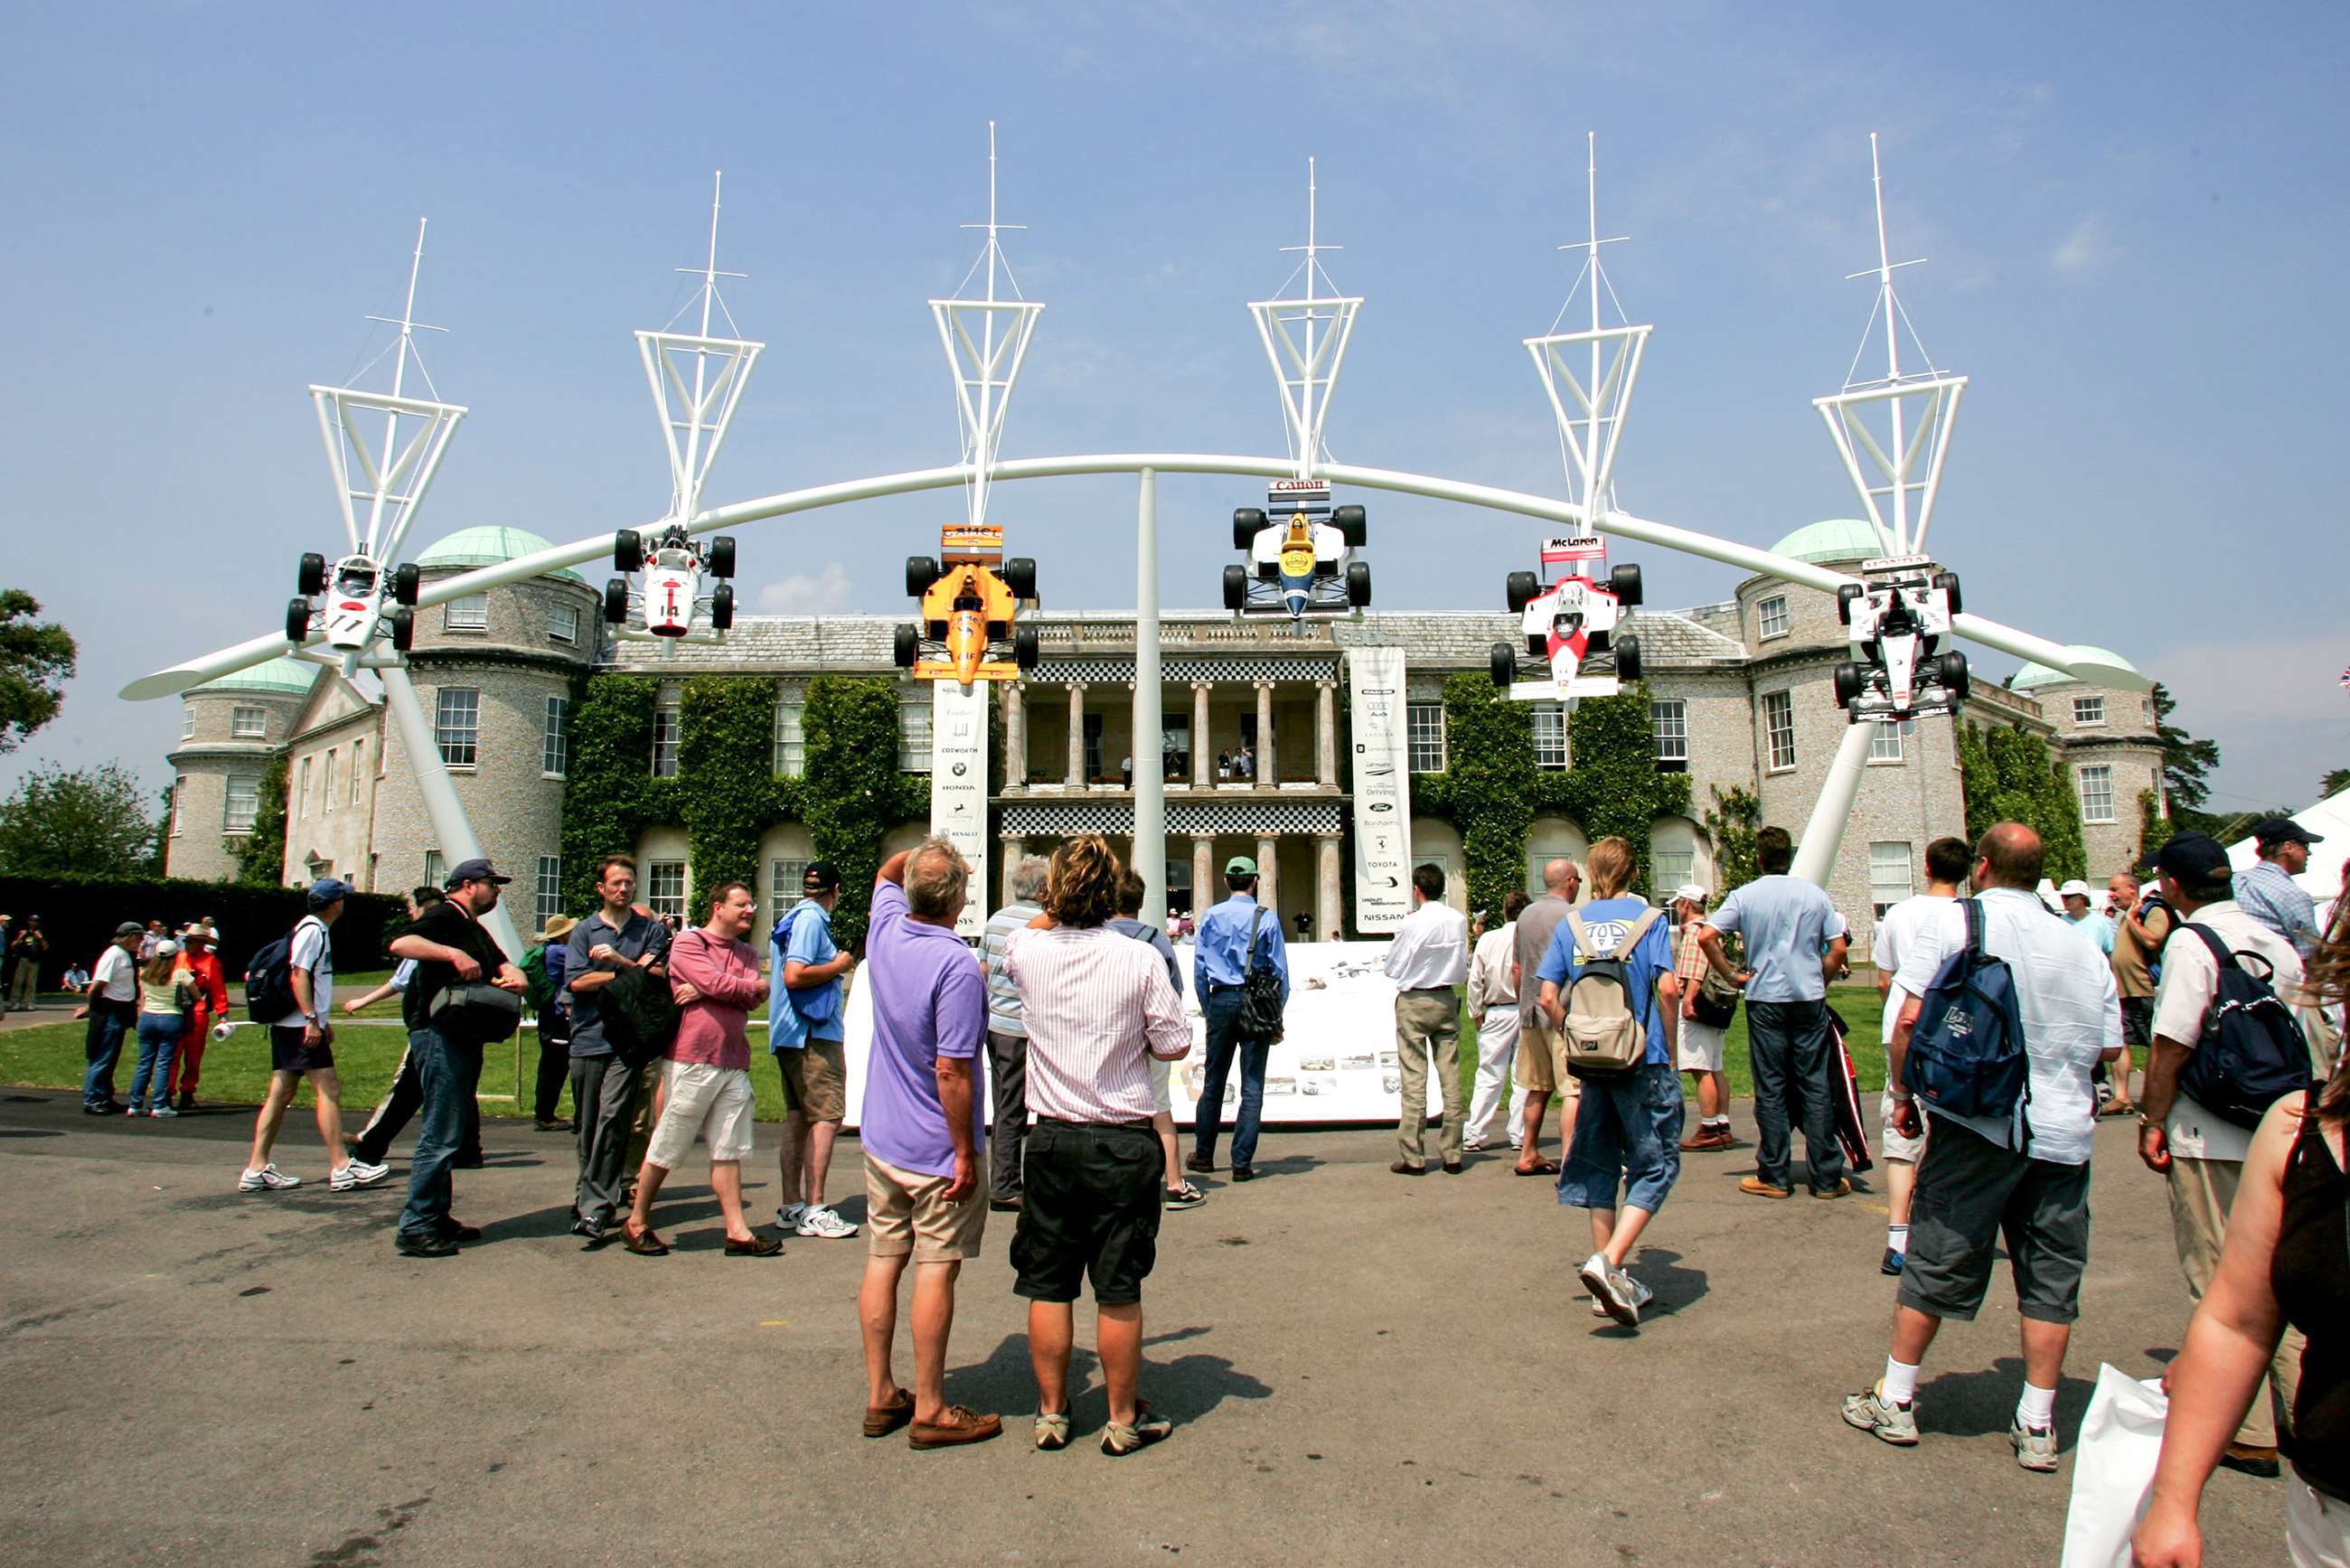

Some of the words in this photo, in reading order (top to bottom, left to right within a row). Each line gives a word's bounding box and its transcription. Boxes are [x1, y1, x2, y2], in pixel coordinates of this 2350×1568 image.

[1276, 480, 1323, 491] Canon
[944, 527, 1001, 538] CAMEL
[1550, 538, 1598, 549] McLaren
[942, 784, 976, 792] HONDA
[1366, 788, 1396, 797] Driving
[1364, 914, 1405, 922] NISSAN
